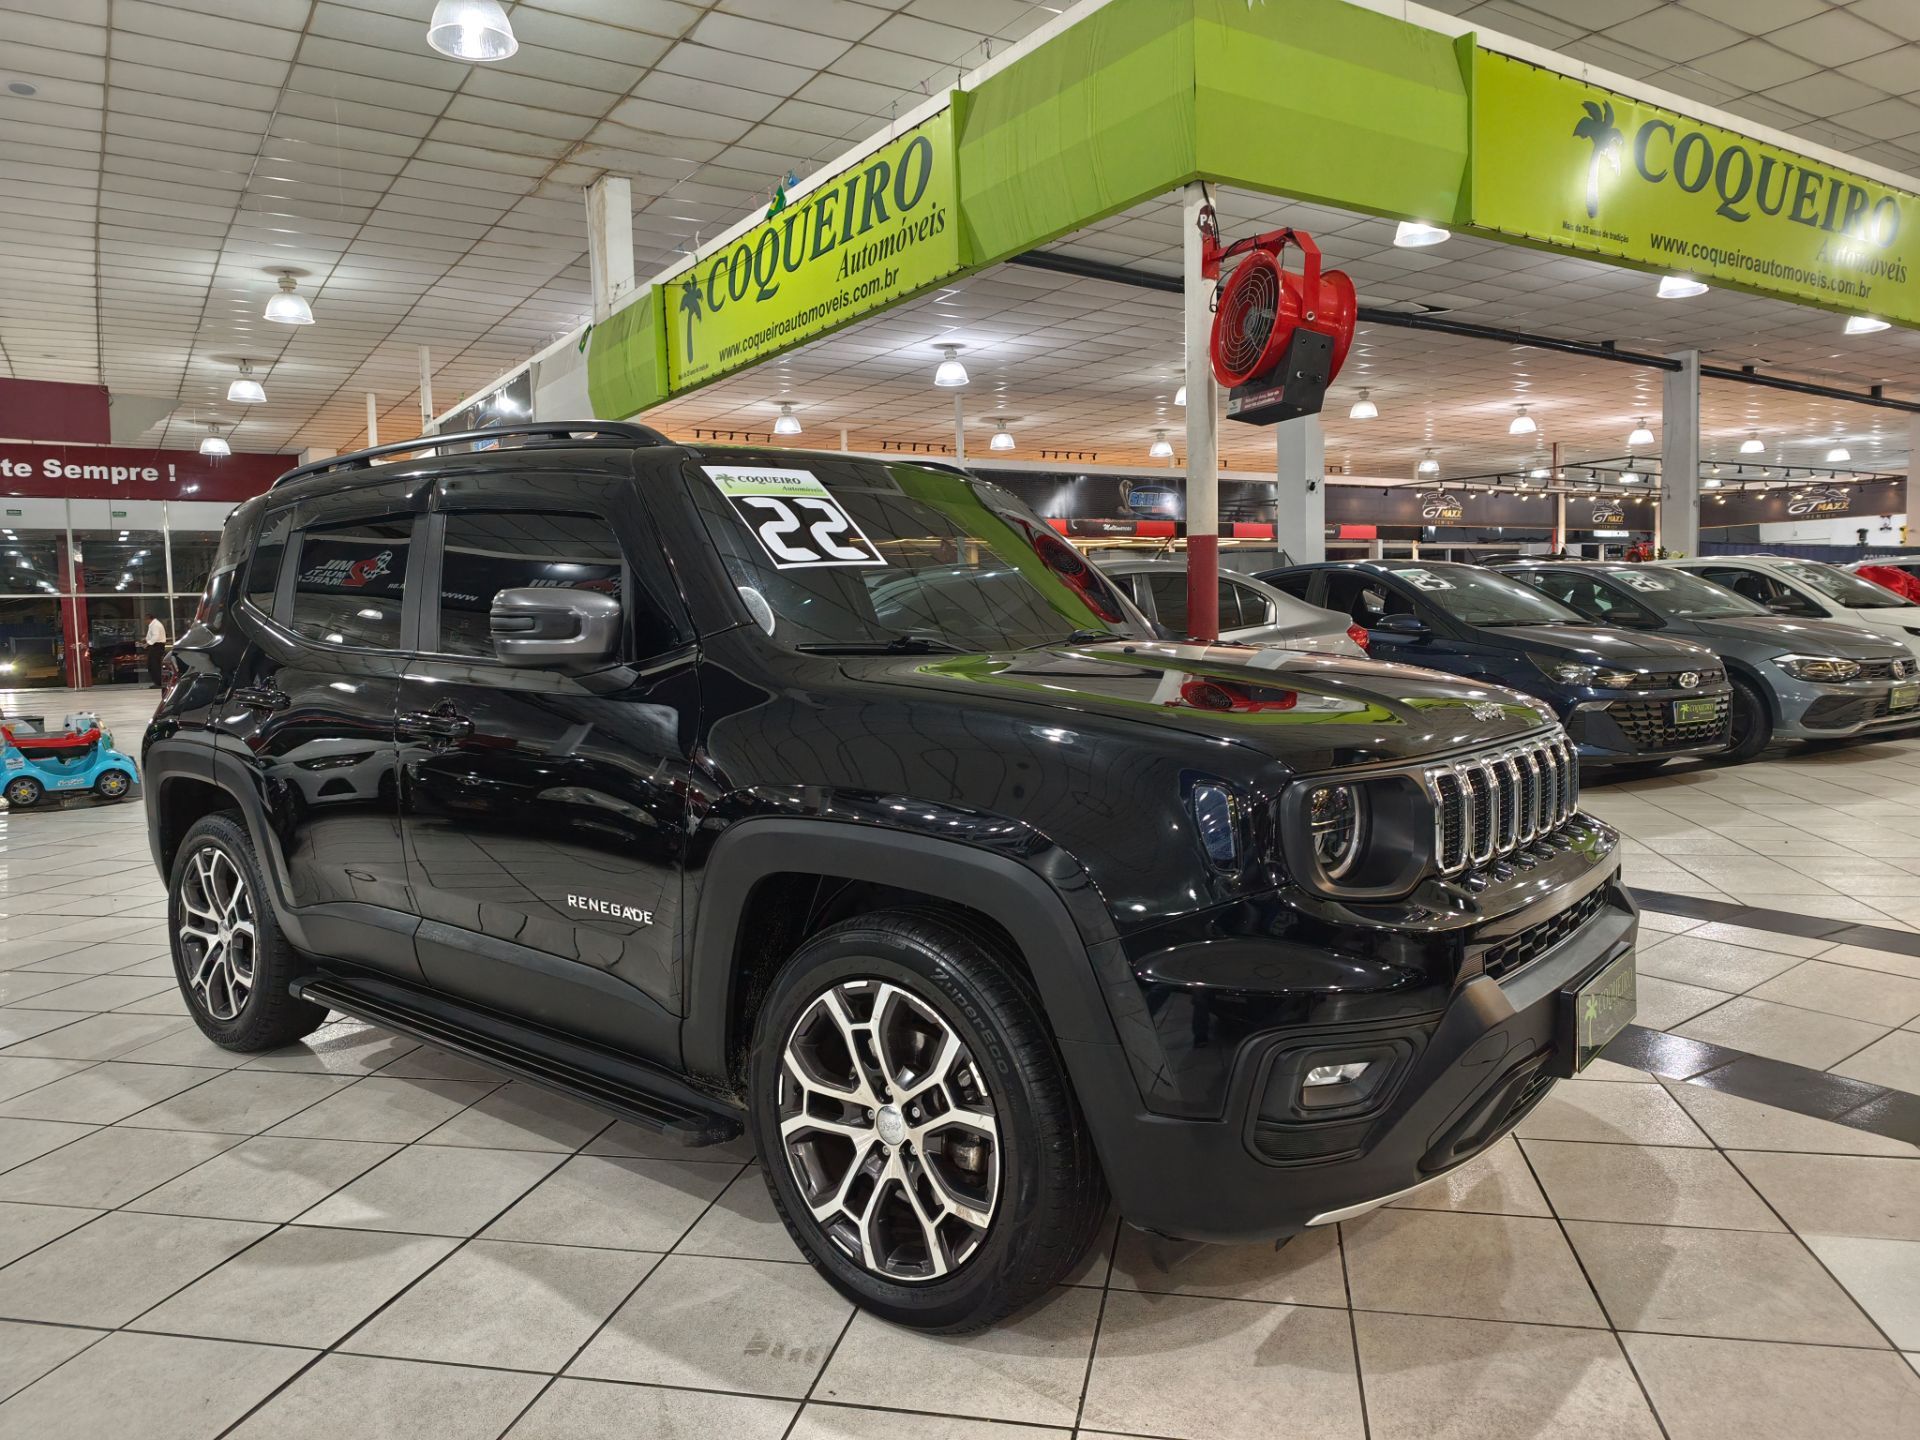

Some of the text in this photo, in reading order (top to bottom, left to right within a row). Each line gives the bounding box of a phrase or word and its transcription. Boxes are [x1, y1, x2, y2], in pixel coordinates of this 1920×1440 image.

[1633, 119, 1900, 248] COQUEIRO
[706, 136, 933, 313] COQUEIRO
[836, 202, 946, 283] Automóveis
[1650, 233, 1872, 299] www.coqueiroautomoveis.com.br
[719, 267, 900, 363] www.coqueiroautomoveis.com.br
[43, 458, 160, 485] Sempre
[737, 475, 802, 486] COQUEIRO
[742, 497, 870, 562] 22
[1422, 506, 1463, 518] GT MAXX
[1592, 512, 1612, 523] GT
[1788, 501, 1850, 514] GT MAXX
[567, 893, 653, 925] RENEGADE
